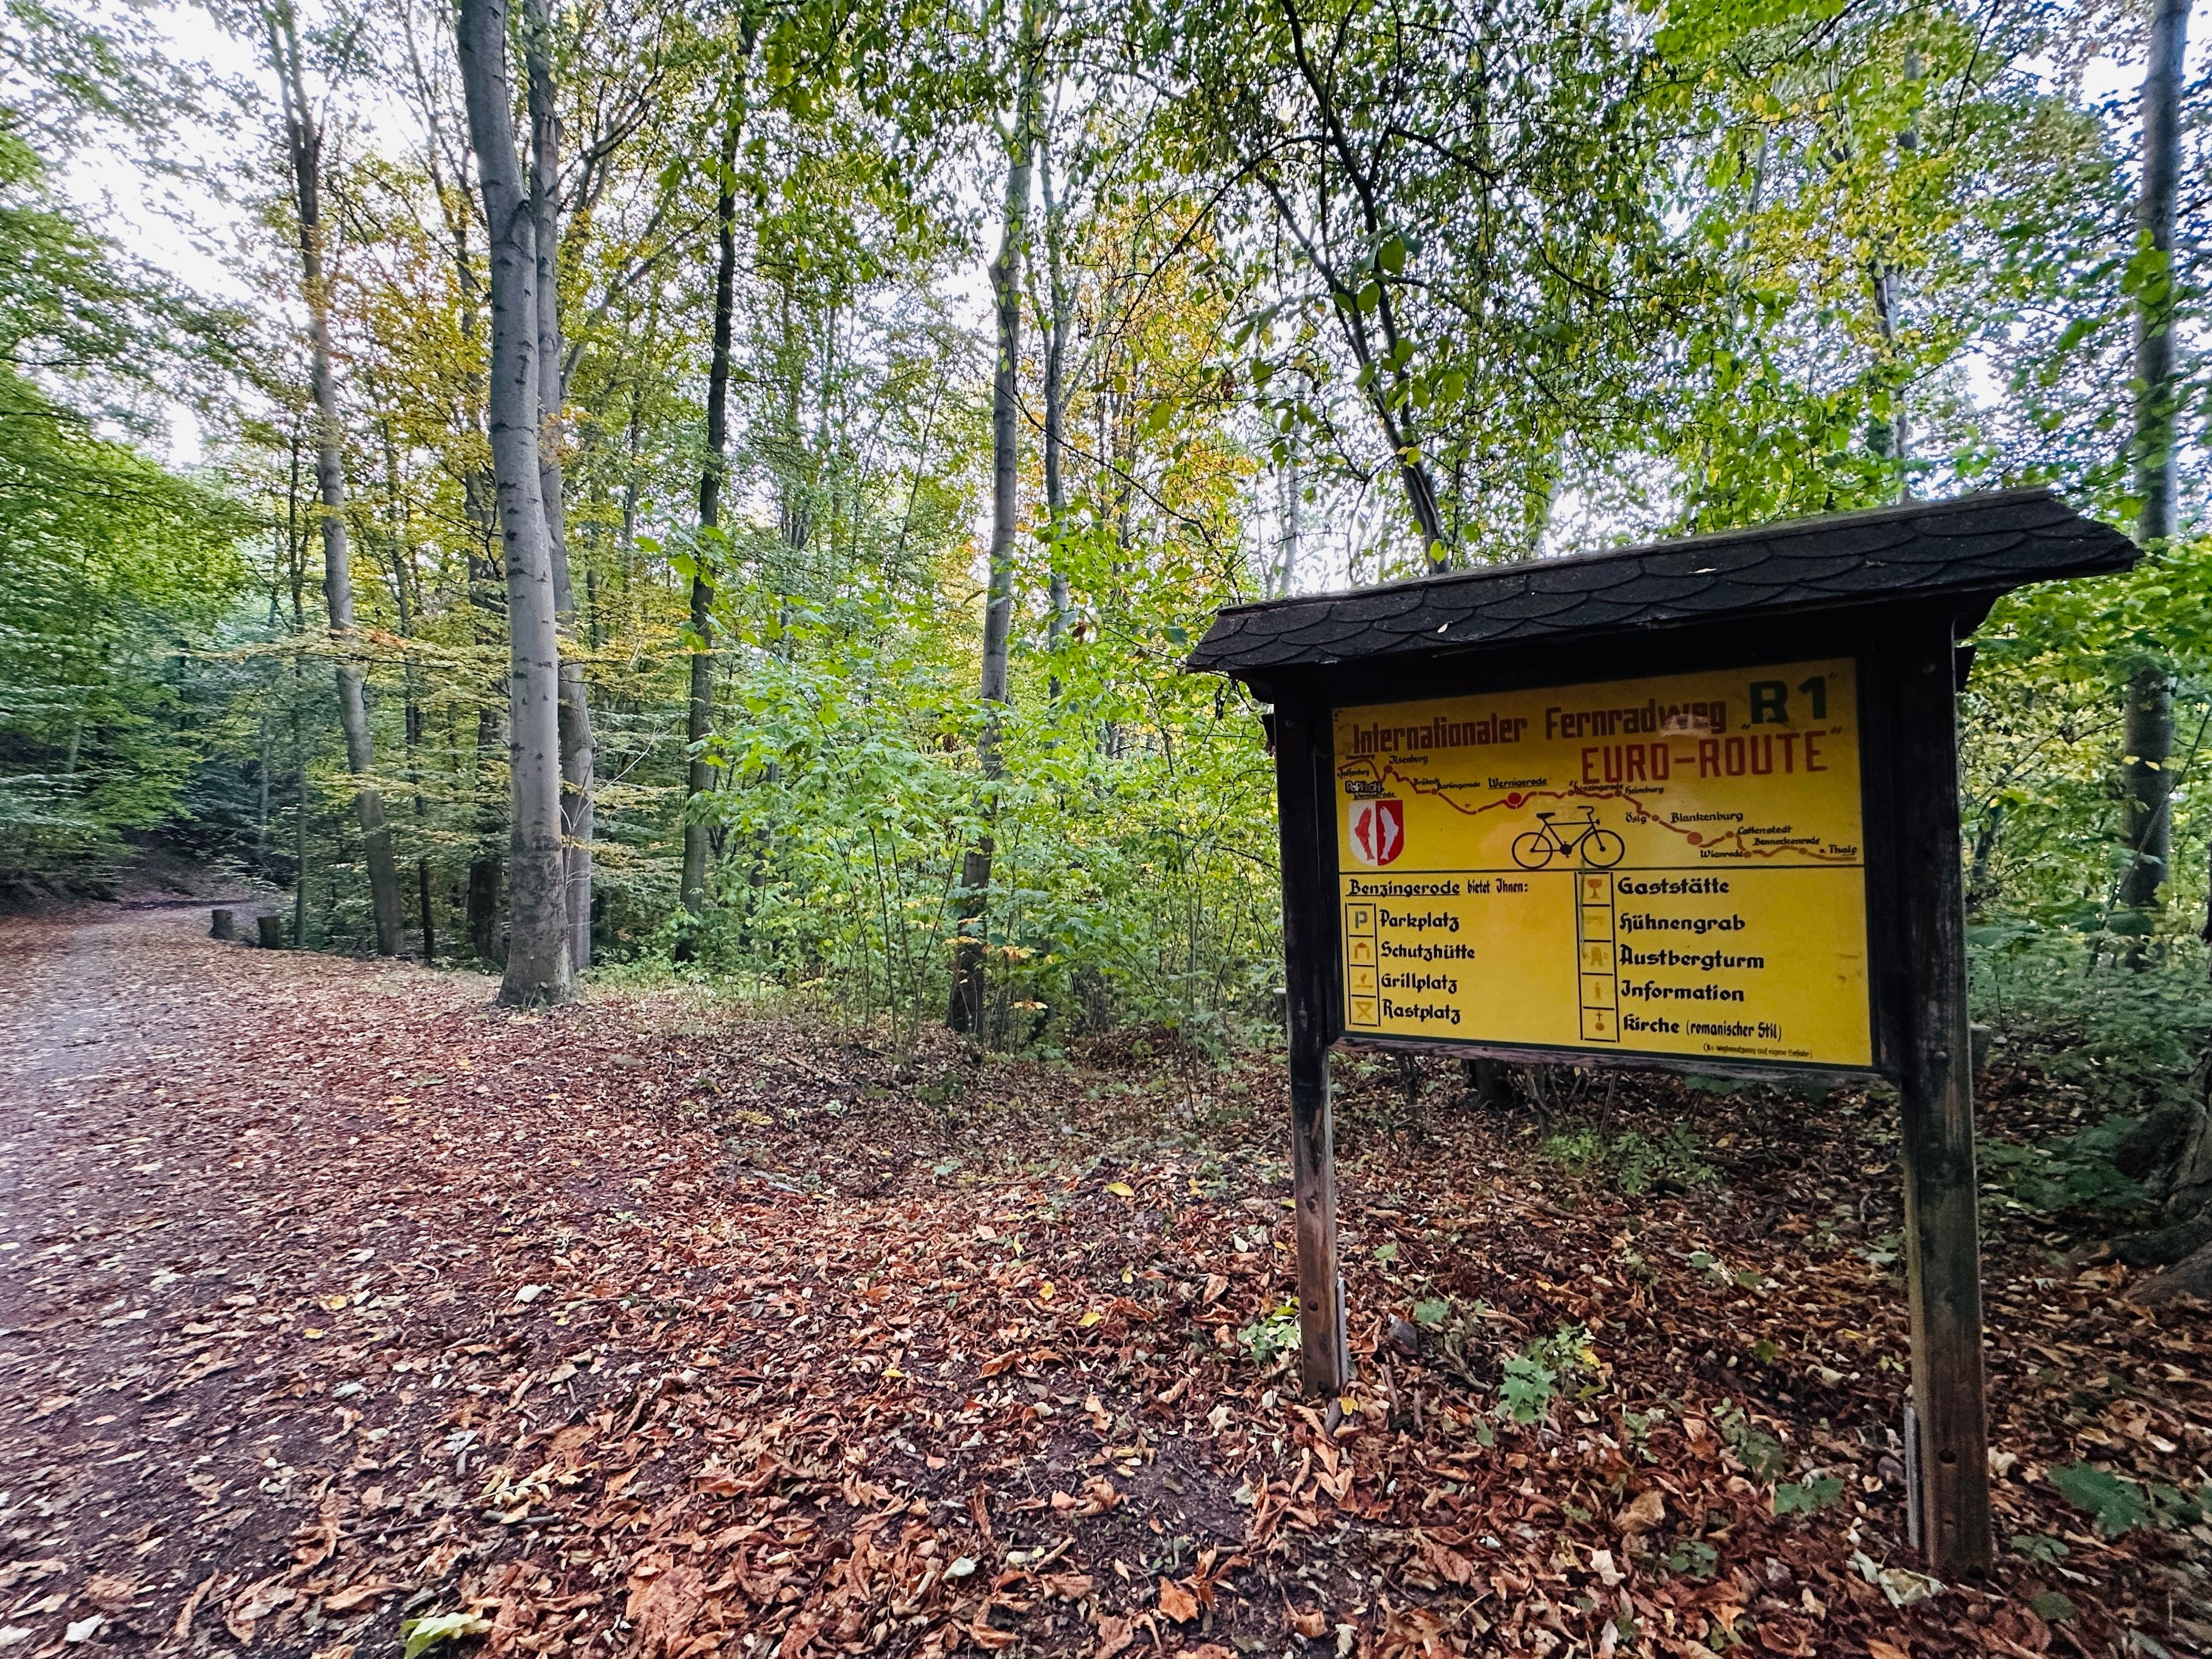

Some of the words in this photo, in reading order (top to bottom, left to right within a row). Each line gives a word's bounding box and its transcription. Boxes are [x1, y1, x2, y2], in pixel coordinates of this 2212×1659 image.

[1354, 713, 1528, 753] Internationaler
[1546, 698, 1726, 740] Fernradweg
[1488, 777, 1547, 788] Wernigerode
[1626, 812, 1646, 823] Ösig
[1671, 813, 1743, 823] Blankenburg
[1737, 825, 1793, 835] Cattenstedt
[1700, 850, 1743, 858] Wienrode
[1828, 844, 1857, 855] Thale
[1349, 879, 1460, 897] Benzingerode
[1468, 880, 1490, 893] bietet
[1618, 877, 1730, 895] Gaststätte
[1379, 910, 1459, 932] Parkplatz
[1619, 912, 1745, 934] Hühnengrab
[1381, 941, 1475, 962] Schutzhütte
[1619, 944, 1764, 971] Austbergturm
[1381, 973, 1457, 994] Grillplatz
[1621, 980, 1744, 1002] Information
[1382, 999, 1460, 1025] Rastplatz
[1623, 1013, 1680, 1033] Kirche
[1686, 1019, 1754, 1037] (romanischer
[1758, 1022, 1782, 1043] Stil)
